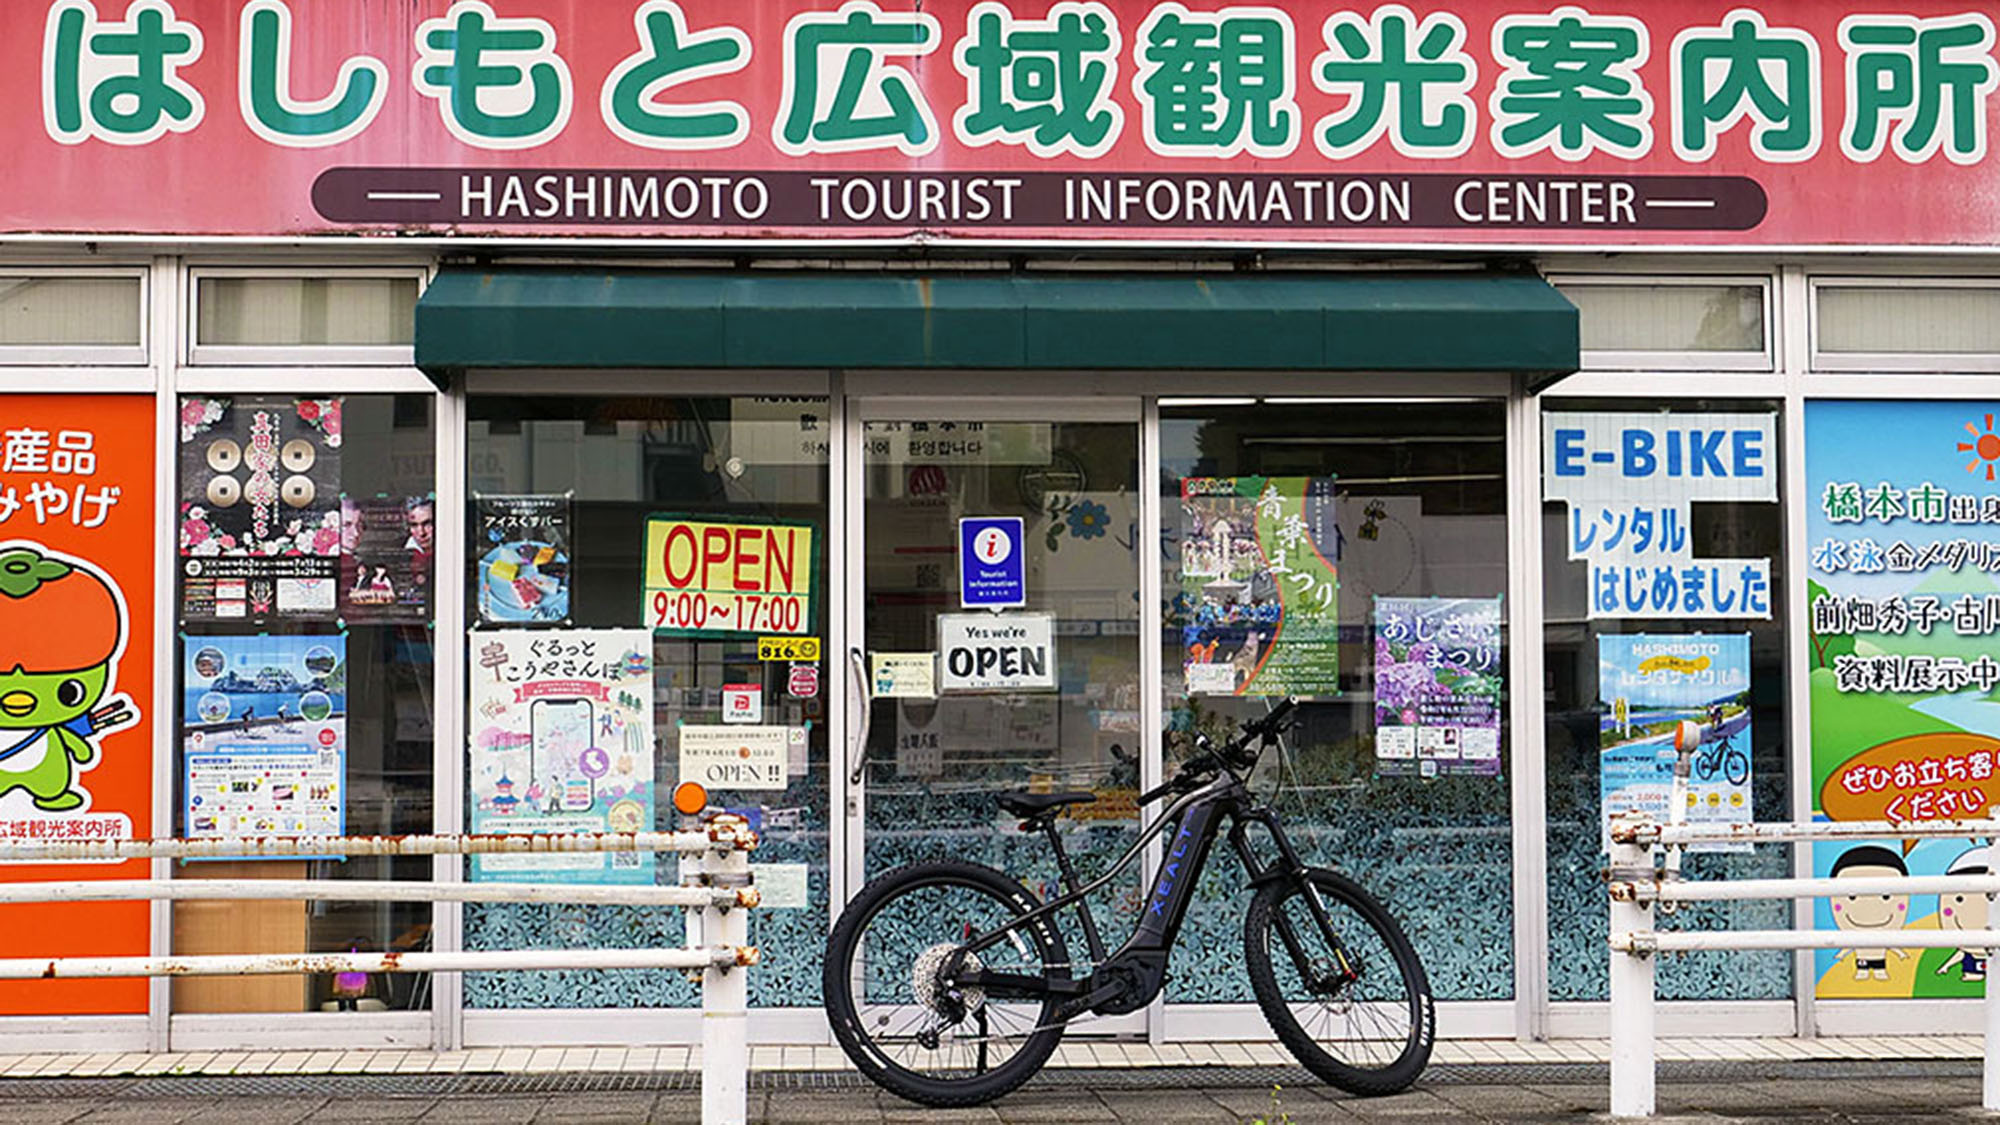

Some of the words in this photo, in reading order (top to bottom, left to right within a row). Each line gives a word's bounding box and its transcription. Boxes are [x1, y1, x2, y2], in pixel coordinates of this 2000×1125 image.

[42, 0, 1996, 164] はしもと広域観光案内所
[460, 175, 769, 220] HASHIMOTO
[811, 178, 1022, 221] TOURIST
[1064, 178, 1410, 223] INFORMATION
[1454, 180, 1637, 223] CENTER
[1555, 429, 1764, 477] E-BIKE
[1574, 507, 1685, 553] レンタル
[663, 524, 795, 594] OPEN
[1594, 566, 1768, 613] はじめました
[966, 626, 989, 638] Yes
[1384, 613, 1495, 642] あじさい
[530, 639, 596, 656] ぐるっと
[948, 646, 1046, 678] OPEN
[1424, 643, 1491, 671] まつり
[1632, 643, 1720, 655] HASHIMOTO
[506, 660, 623, 681] こうやさんぽ
[1838, 658, 1998, 689] 資料展示中
[706, 764, 761, 782] OPEN
[1886, 788, 1985, 822] ください
[1150, 825, 1192, 916] XEALT
